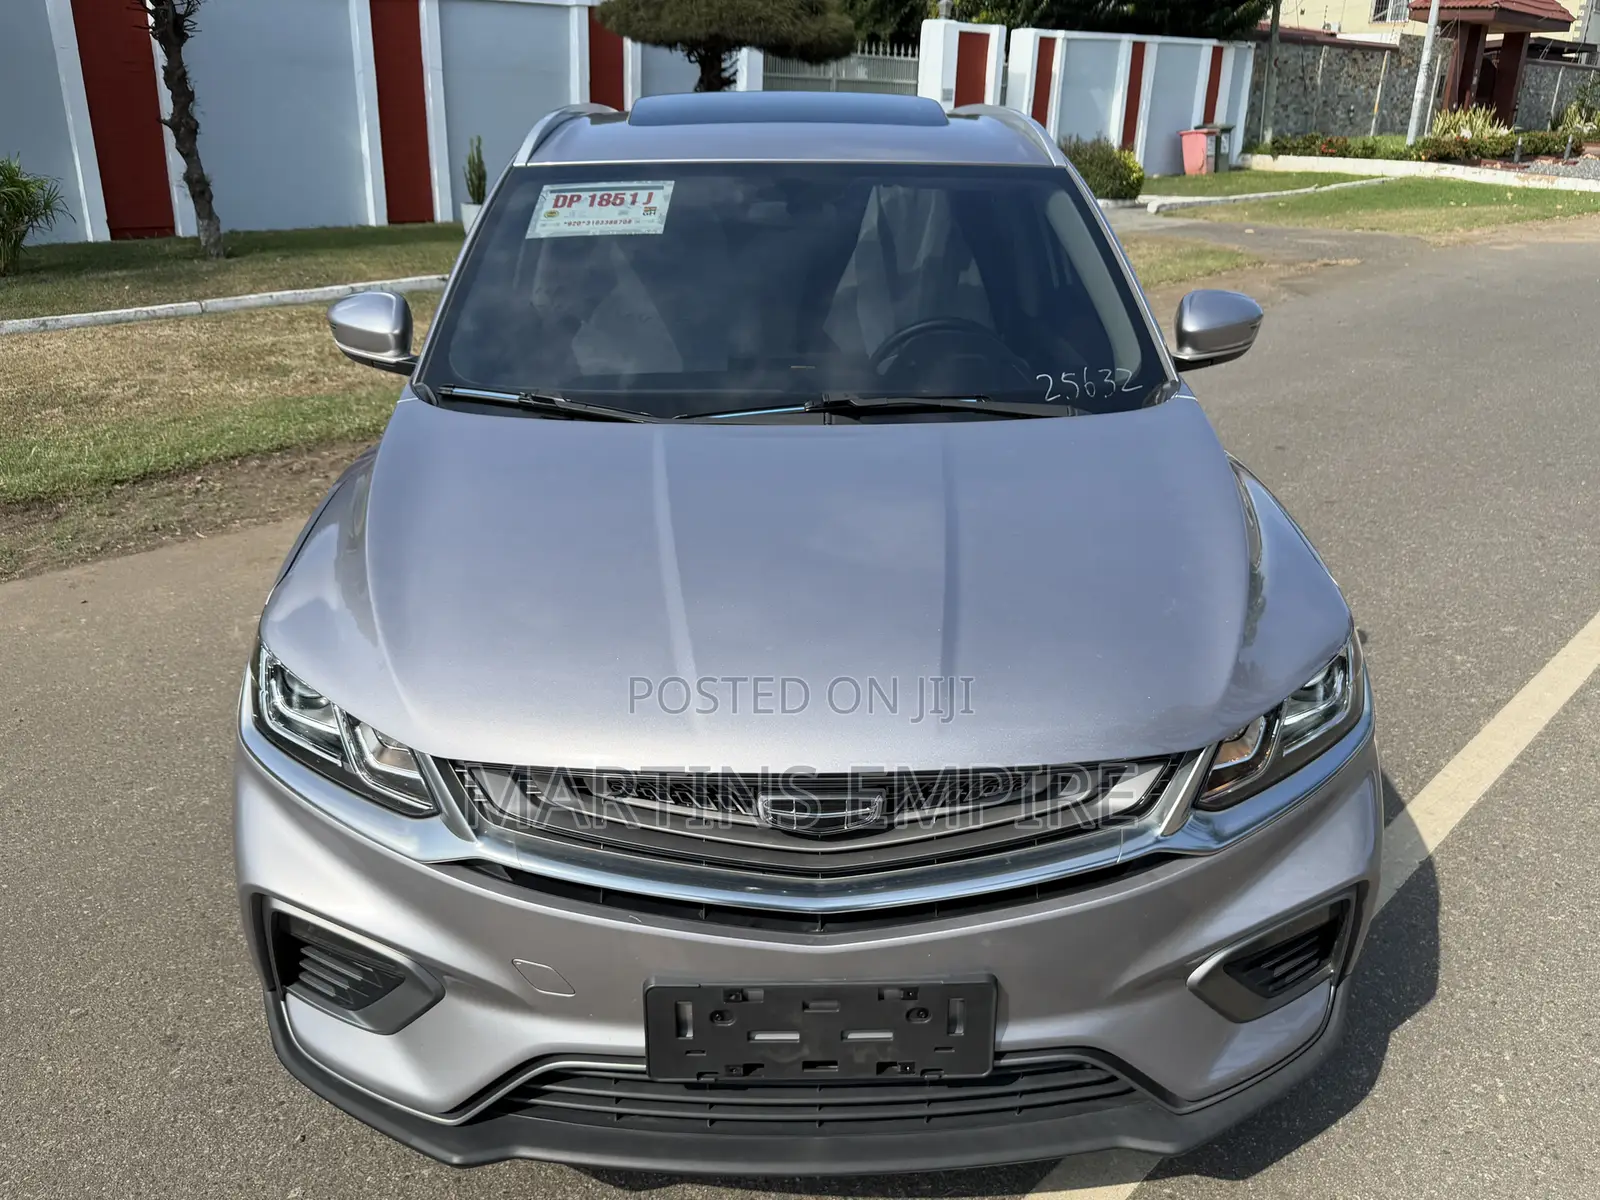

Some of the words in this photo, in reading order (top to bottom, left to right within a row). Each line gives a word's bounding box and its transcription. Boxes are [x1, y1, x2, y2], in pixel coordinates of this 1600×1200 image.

[553, 194, 582, 209] DP
[588, 192, 639, 207] 1851
[643, 192, 653, 205] J
[1036, 366, 1143, 402] 25632
